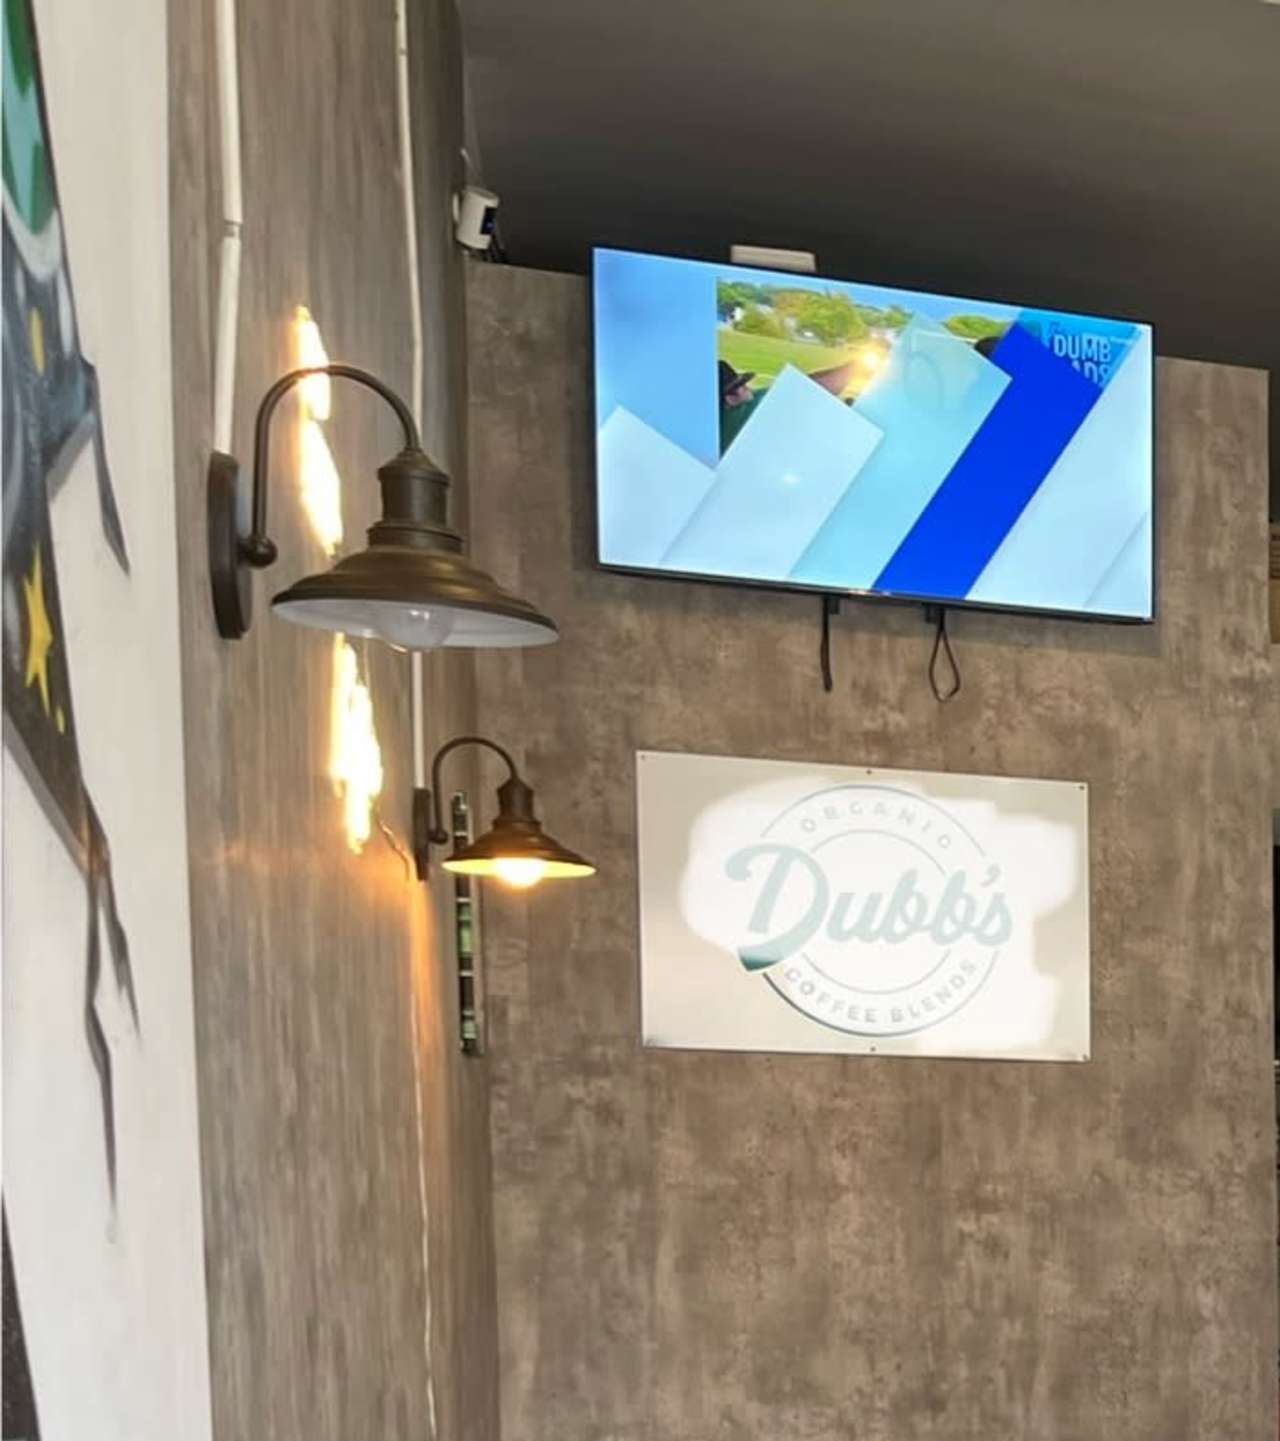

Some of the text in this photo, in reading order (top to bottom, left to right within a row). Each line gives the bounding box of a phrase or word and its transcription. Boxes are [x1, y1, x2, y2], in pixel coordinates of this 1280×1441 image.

[1054, 333, 1111, 362] DUMB
[800, 801, 953, 849] ORGANIC
[724, 842, 1012, 971] Dubb's
[784, 959, 977, 1025] COFFEE BLENDS
